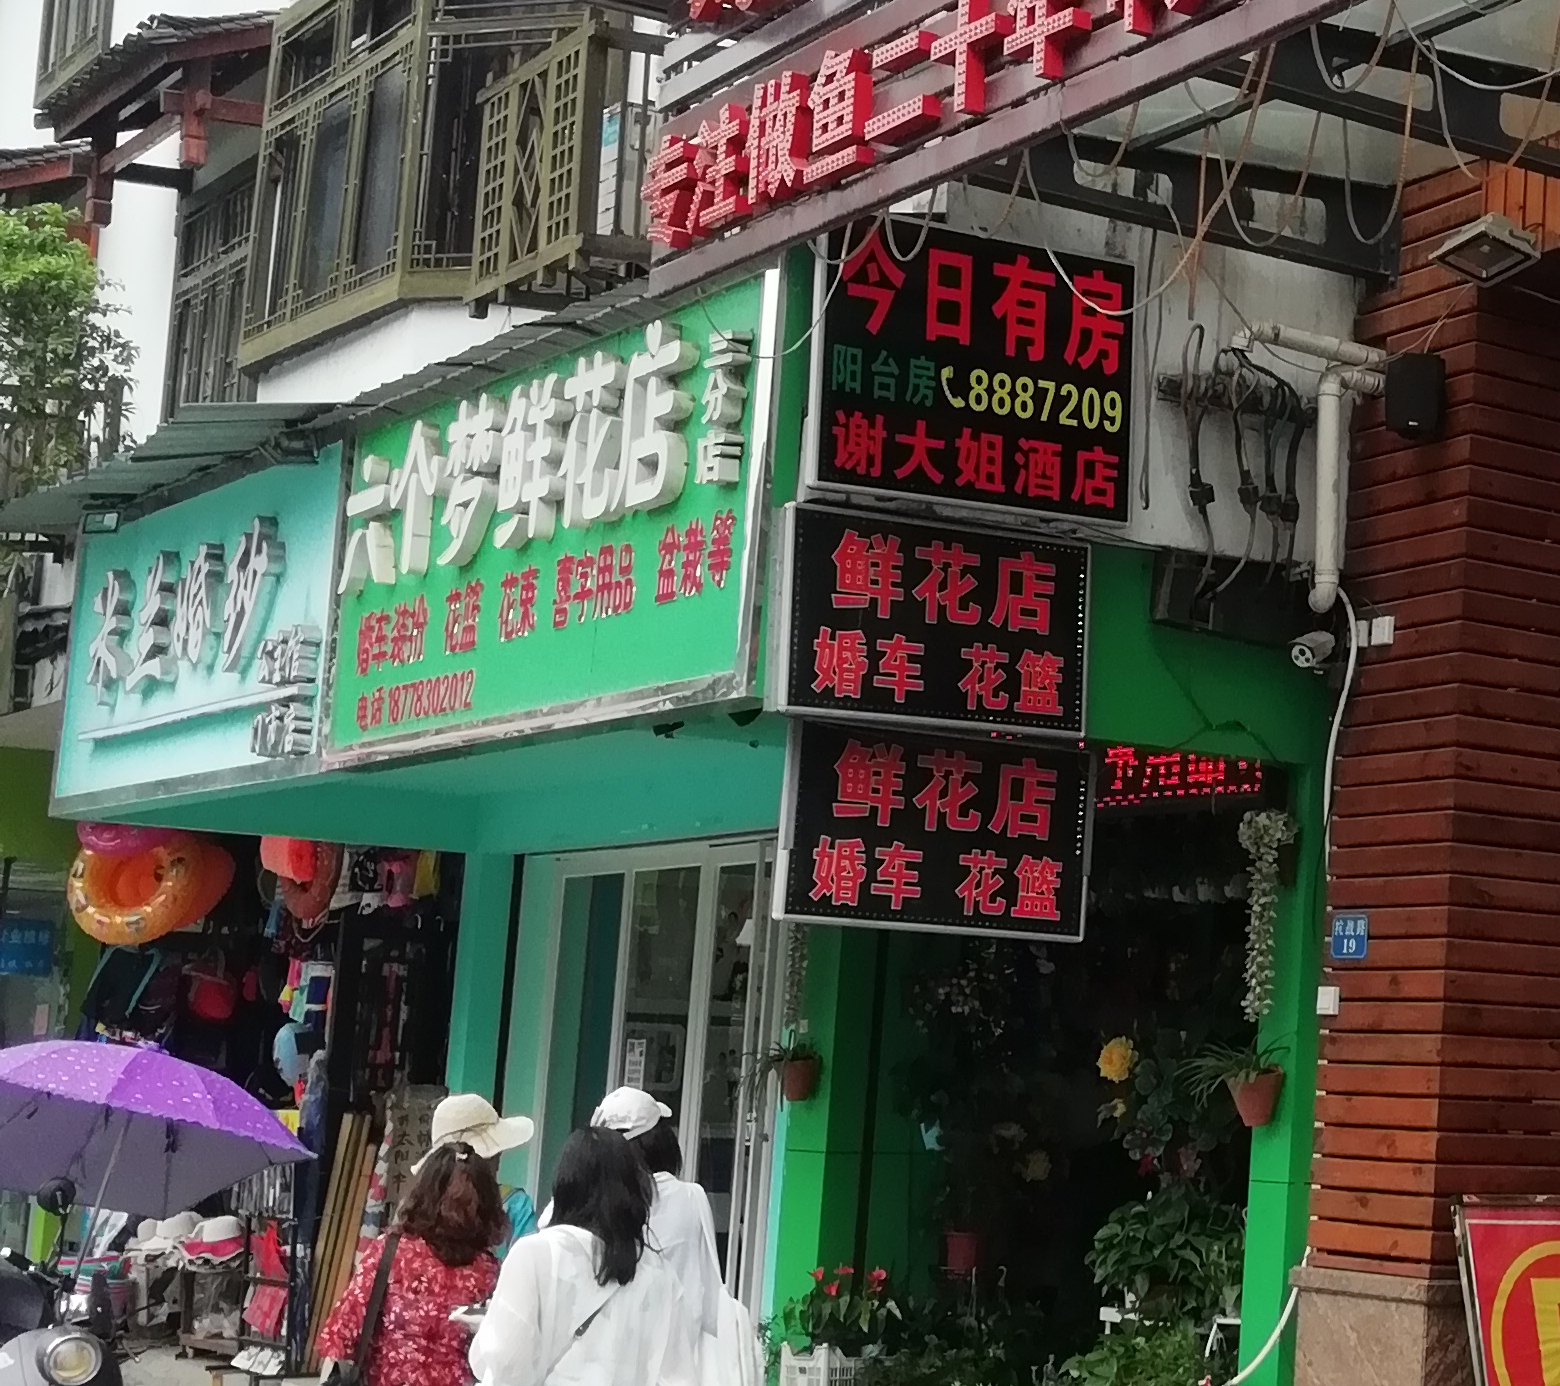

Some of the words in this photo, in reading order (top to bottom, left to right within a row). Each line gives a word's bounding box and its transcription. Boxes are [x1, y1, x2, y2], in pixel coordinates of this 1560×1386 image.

[842, 226, 1124, 376] 今日有房
[832, 343, 937, 407] 阳台房
[968, 368, 1123, 433] 8887209
[832, 409, 1119, 509] 谢大姐酒店
[831, 527, 1057, 635] 鲜花店
[811, 626, 925, 703] 婚车
[958, 642, 1064, 716] 花篮
[832, 738, 1057, 841] 鲜花店
[809, 835, 923, 910] 婚车
[956, 849, 1063, 922] 花篮
[1342, 938, 1356, 954] 19
